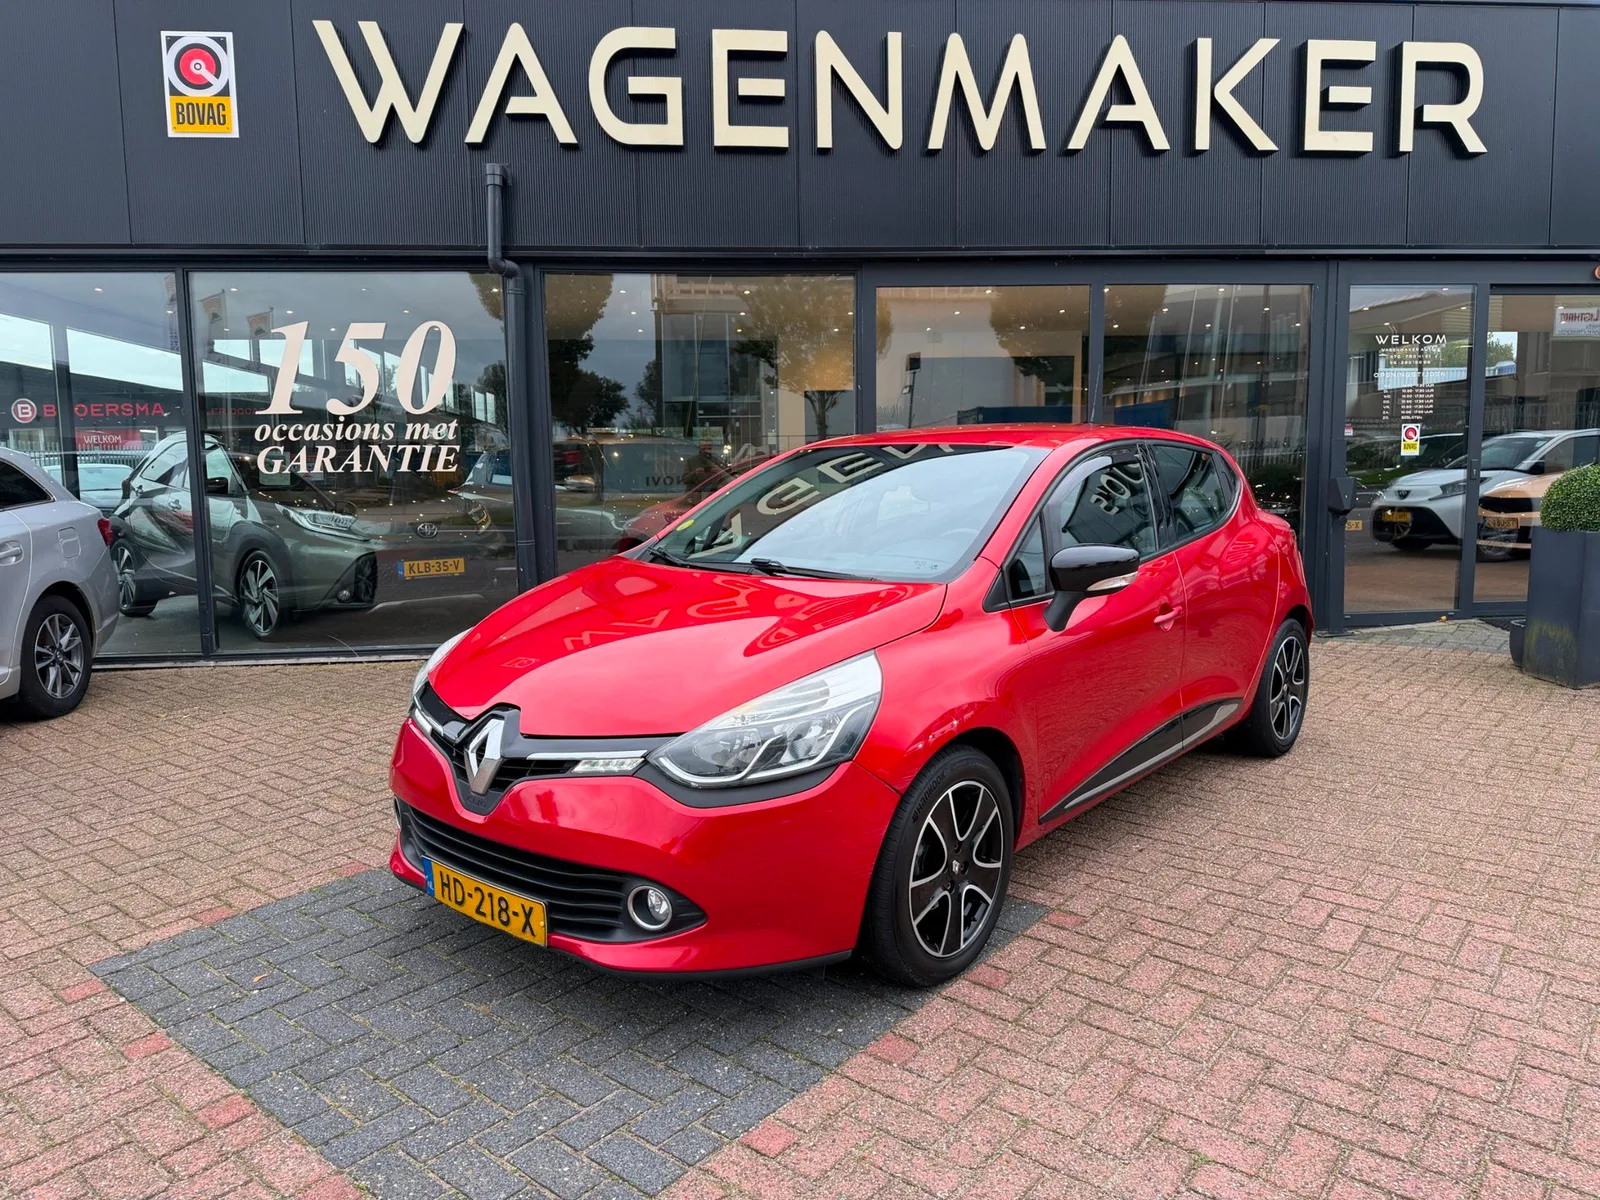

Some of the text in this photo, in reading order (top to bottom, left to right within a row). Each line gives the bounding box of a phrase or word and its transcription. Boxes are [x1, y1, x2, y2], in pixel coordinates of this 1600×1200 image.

[312, 20, 1488, 155] WAGENMAKER
[176, 102, 228, 127] BOVAG
[1375, 334, 1447, 345] WELKOM
[255, 320, 457, 416] 150
[43, 402, 165, 418] BOERSMA
[83, 433, 122, 445] WELKOM
[254, 415, 459, 442] occasions met
[257, 445, 460, 475] GARANTIE
[408, 559, 461, 575] KLB-35-V
[439, 869, 537, 938] HD-218-X
